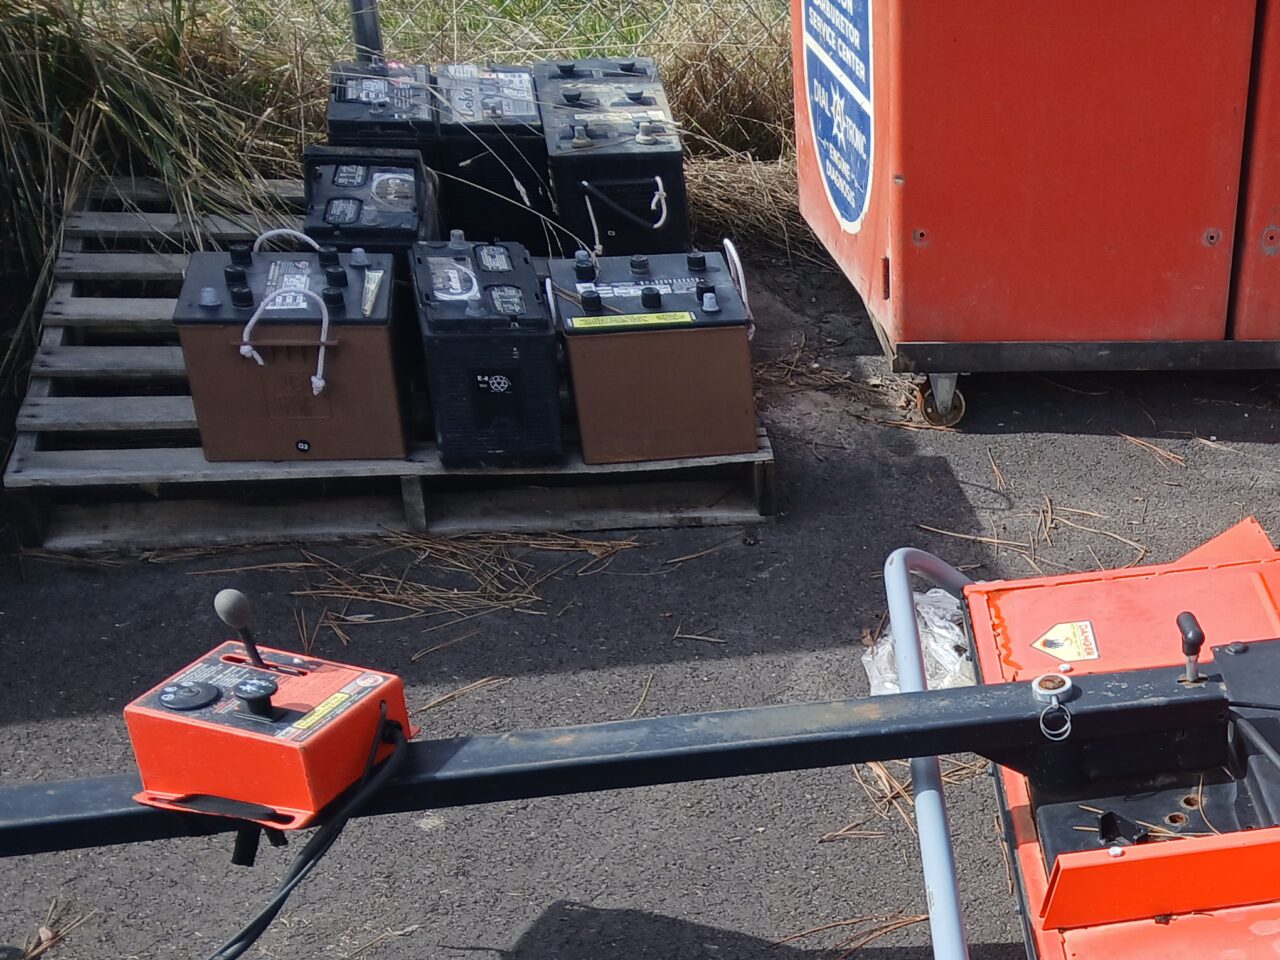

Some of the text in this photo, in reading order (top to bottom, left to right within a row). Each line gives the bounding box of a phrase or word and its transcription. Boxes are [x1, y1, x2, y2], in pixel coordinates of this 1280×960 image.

[808, 6, 836, 50] SERVICE
[838, 37, 866, 84] CENTER
[812, 0, 861, 51] ARBURETOR
